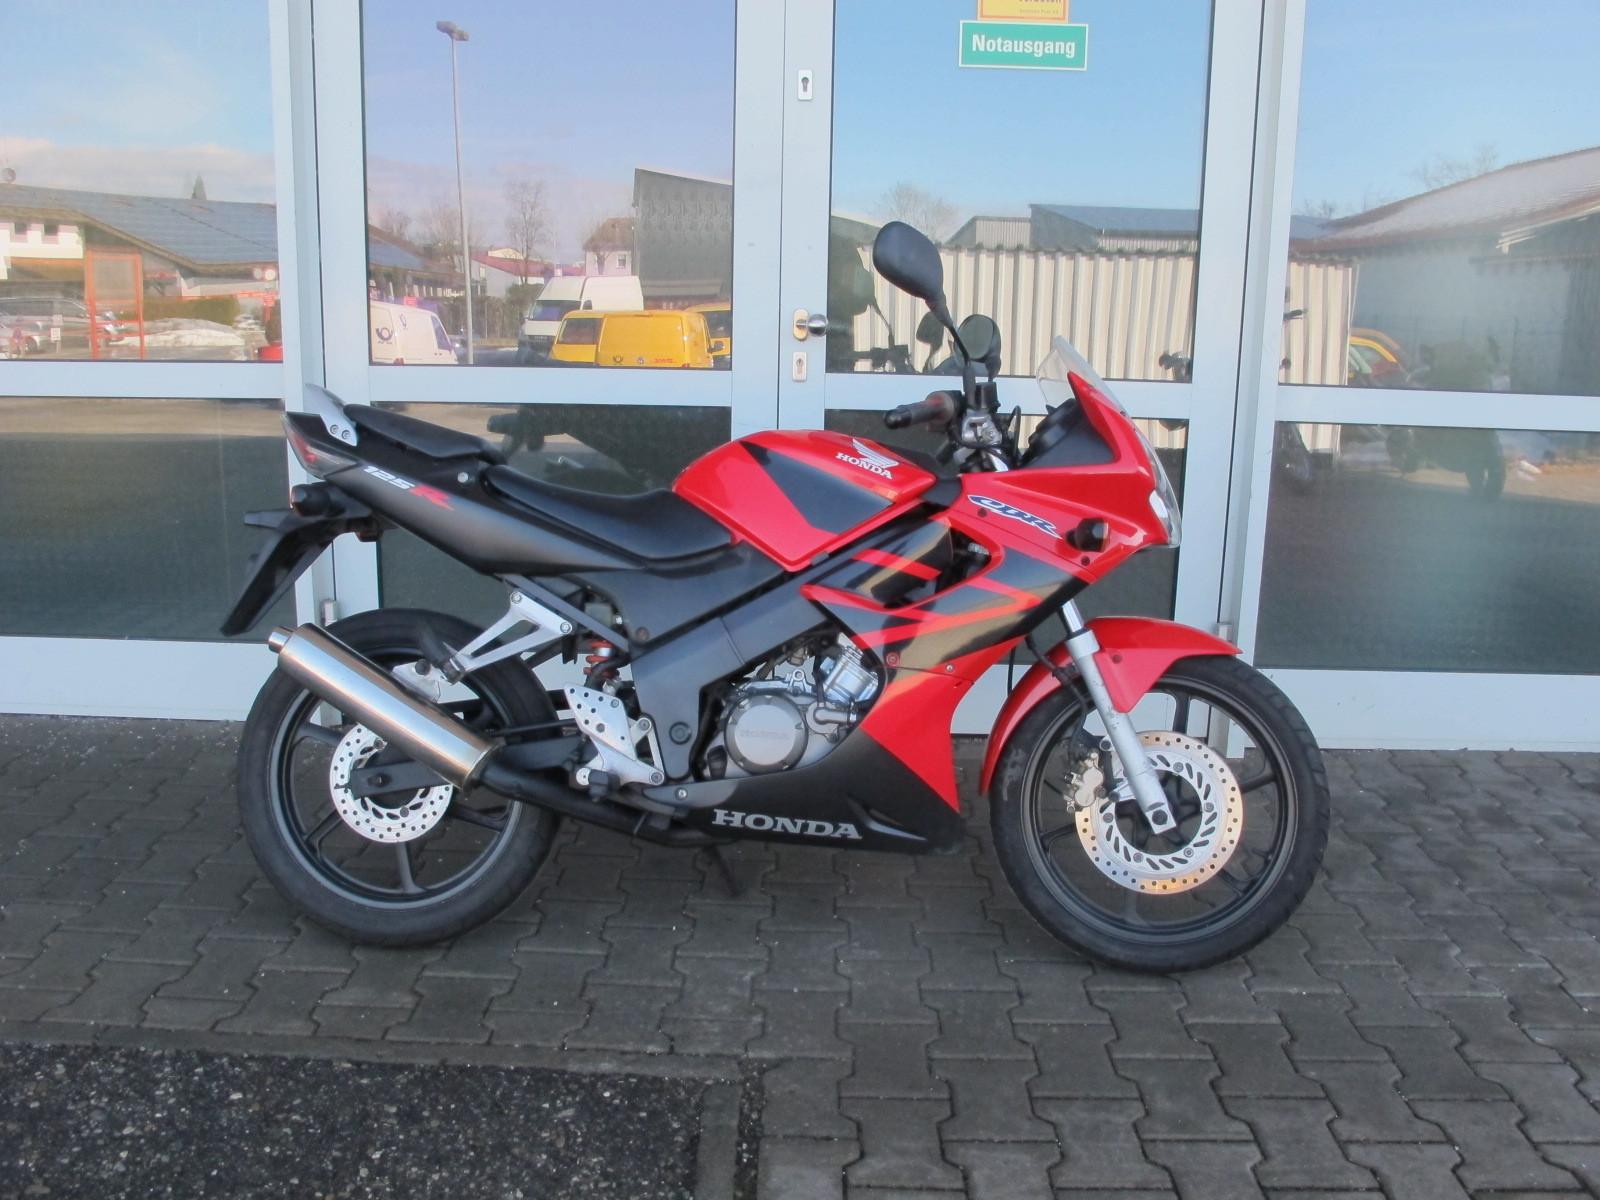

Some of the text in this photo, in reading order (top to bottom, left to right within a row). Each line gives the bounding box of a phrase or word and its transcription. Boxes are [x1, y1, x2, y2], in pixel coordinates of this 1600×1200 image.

[971, 33, 1076, 59] Notausgang
[835, 452, 893, 480] HONDA
[967, 494, 1064, 540] CBR
[711, 808, 863, 840] HONDA
